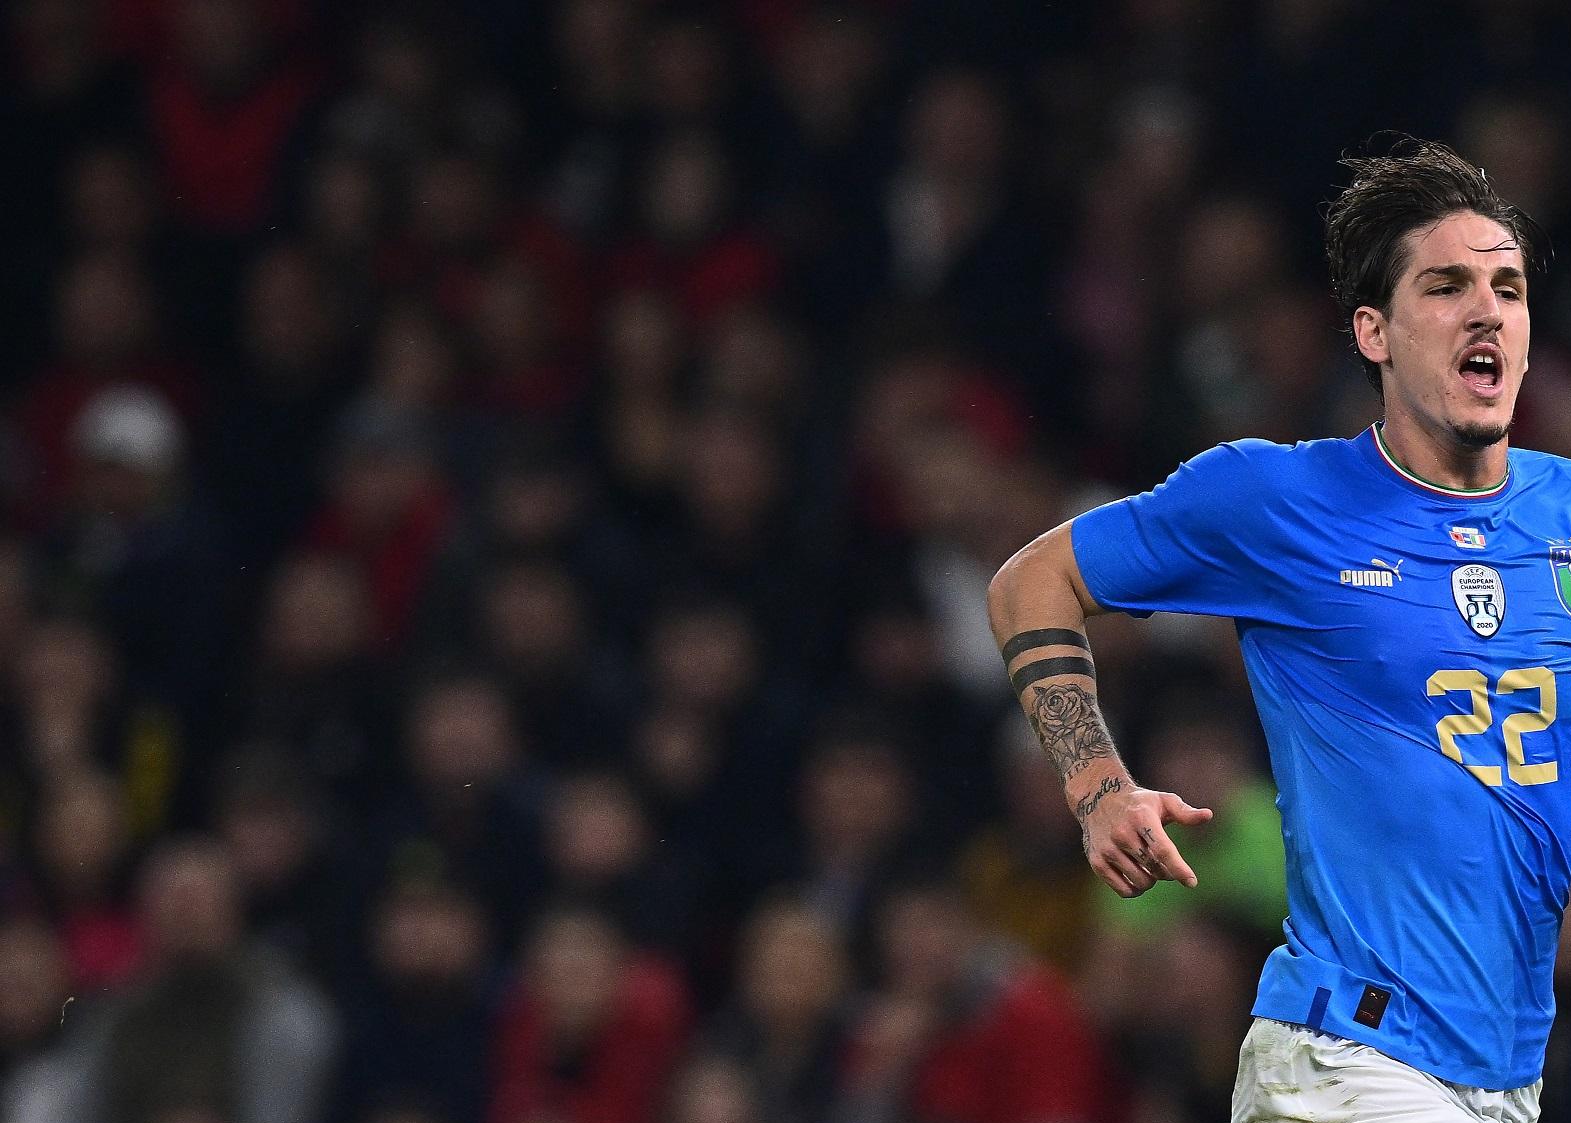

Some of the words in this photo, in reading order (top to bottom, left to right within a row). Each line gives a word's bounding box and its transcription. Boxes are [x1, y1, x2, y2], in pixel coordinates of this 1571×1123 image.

[1339, 569, 1394, 587] PUMA
[1464, 567, 1484, 577] UEFA
[1426, 666, 1559, 787] 22
